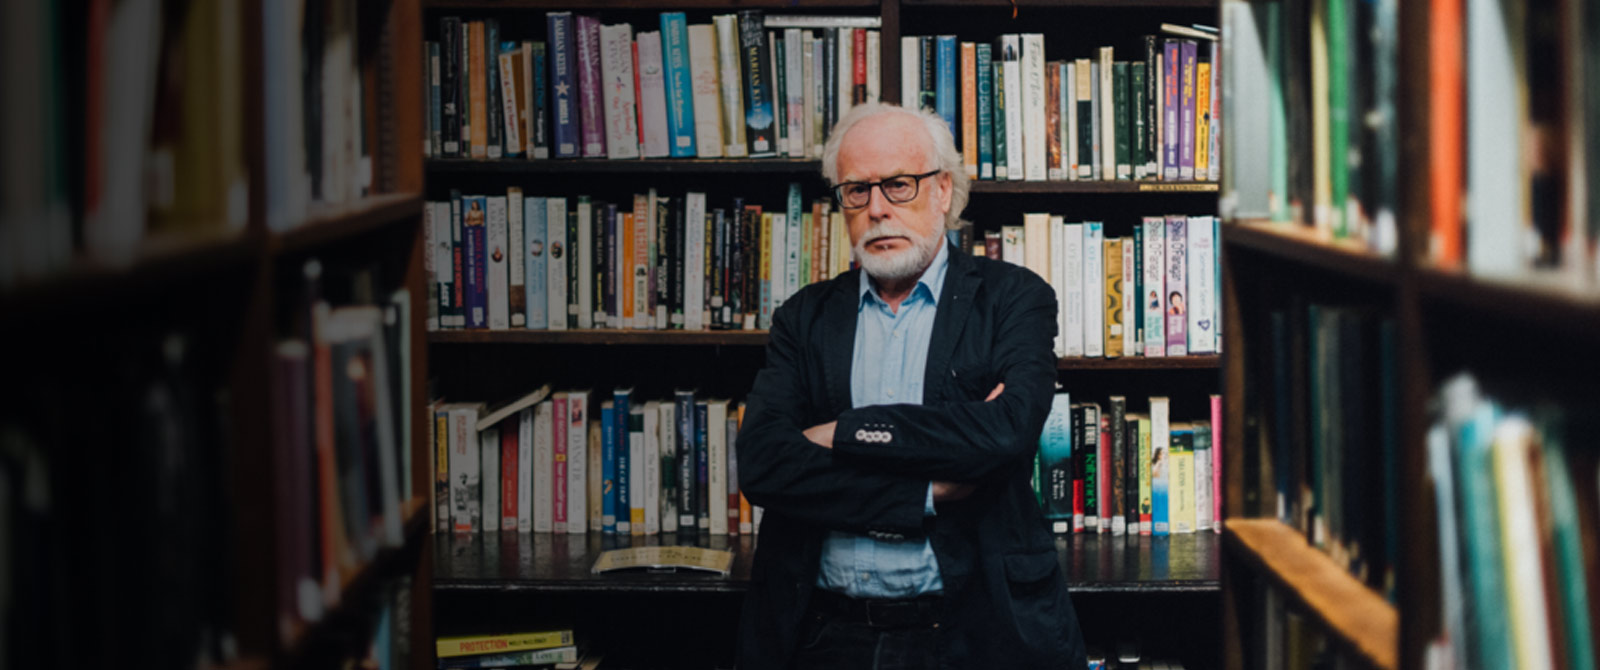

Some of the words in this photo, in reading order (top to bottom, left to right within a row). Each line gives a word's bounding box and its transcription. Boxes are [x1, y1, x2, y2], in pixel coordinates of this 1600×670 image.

[554, 19, 565, 51] MARIAN
[577, 27, 588, 63] KEYES
[590, 24, 601, 67] MARIAN
[670, 20, 681, 46] MARIAN
[557, 53, 567, 76] KEYES
[608, 40, 619, 73] KEYES
[619, 33, 632, 74] MARIAN
[671, 48, 683, 70] KEYES
[749, 46, 761, 87] MARIAN
[752, 88, 763, 121] KEYES
[489, 202, 497, 241] LARKIN
[498, 207, 506, 236] MARY
[1148, 221, 1162, 242] Sheila
[1169, 221, 1184, 242] Sheila
[1146, 243, 1162, 282] O'Flanagan
[1168, 243, 1184, 282] O'Flanagan
[1114, 405, 1123, 430] Patricia
[1085, 453, 1097, 508] Kilbrack
[459, 639, 508, 653] PROTECTION
